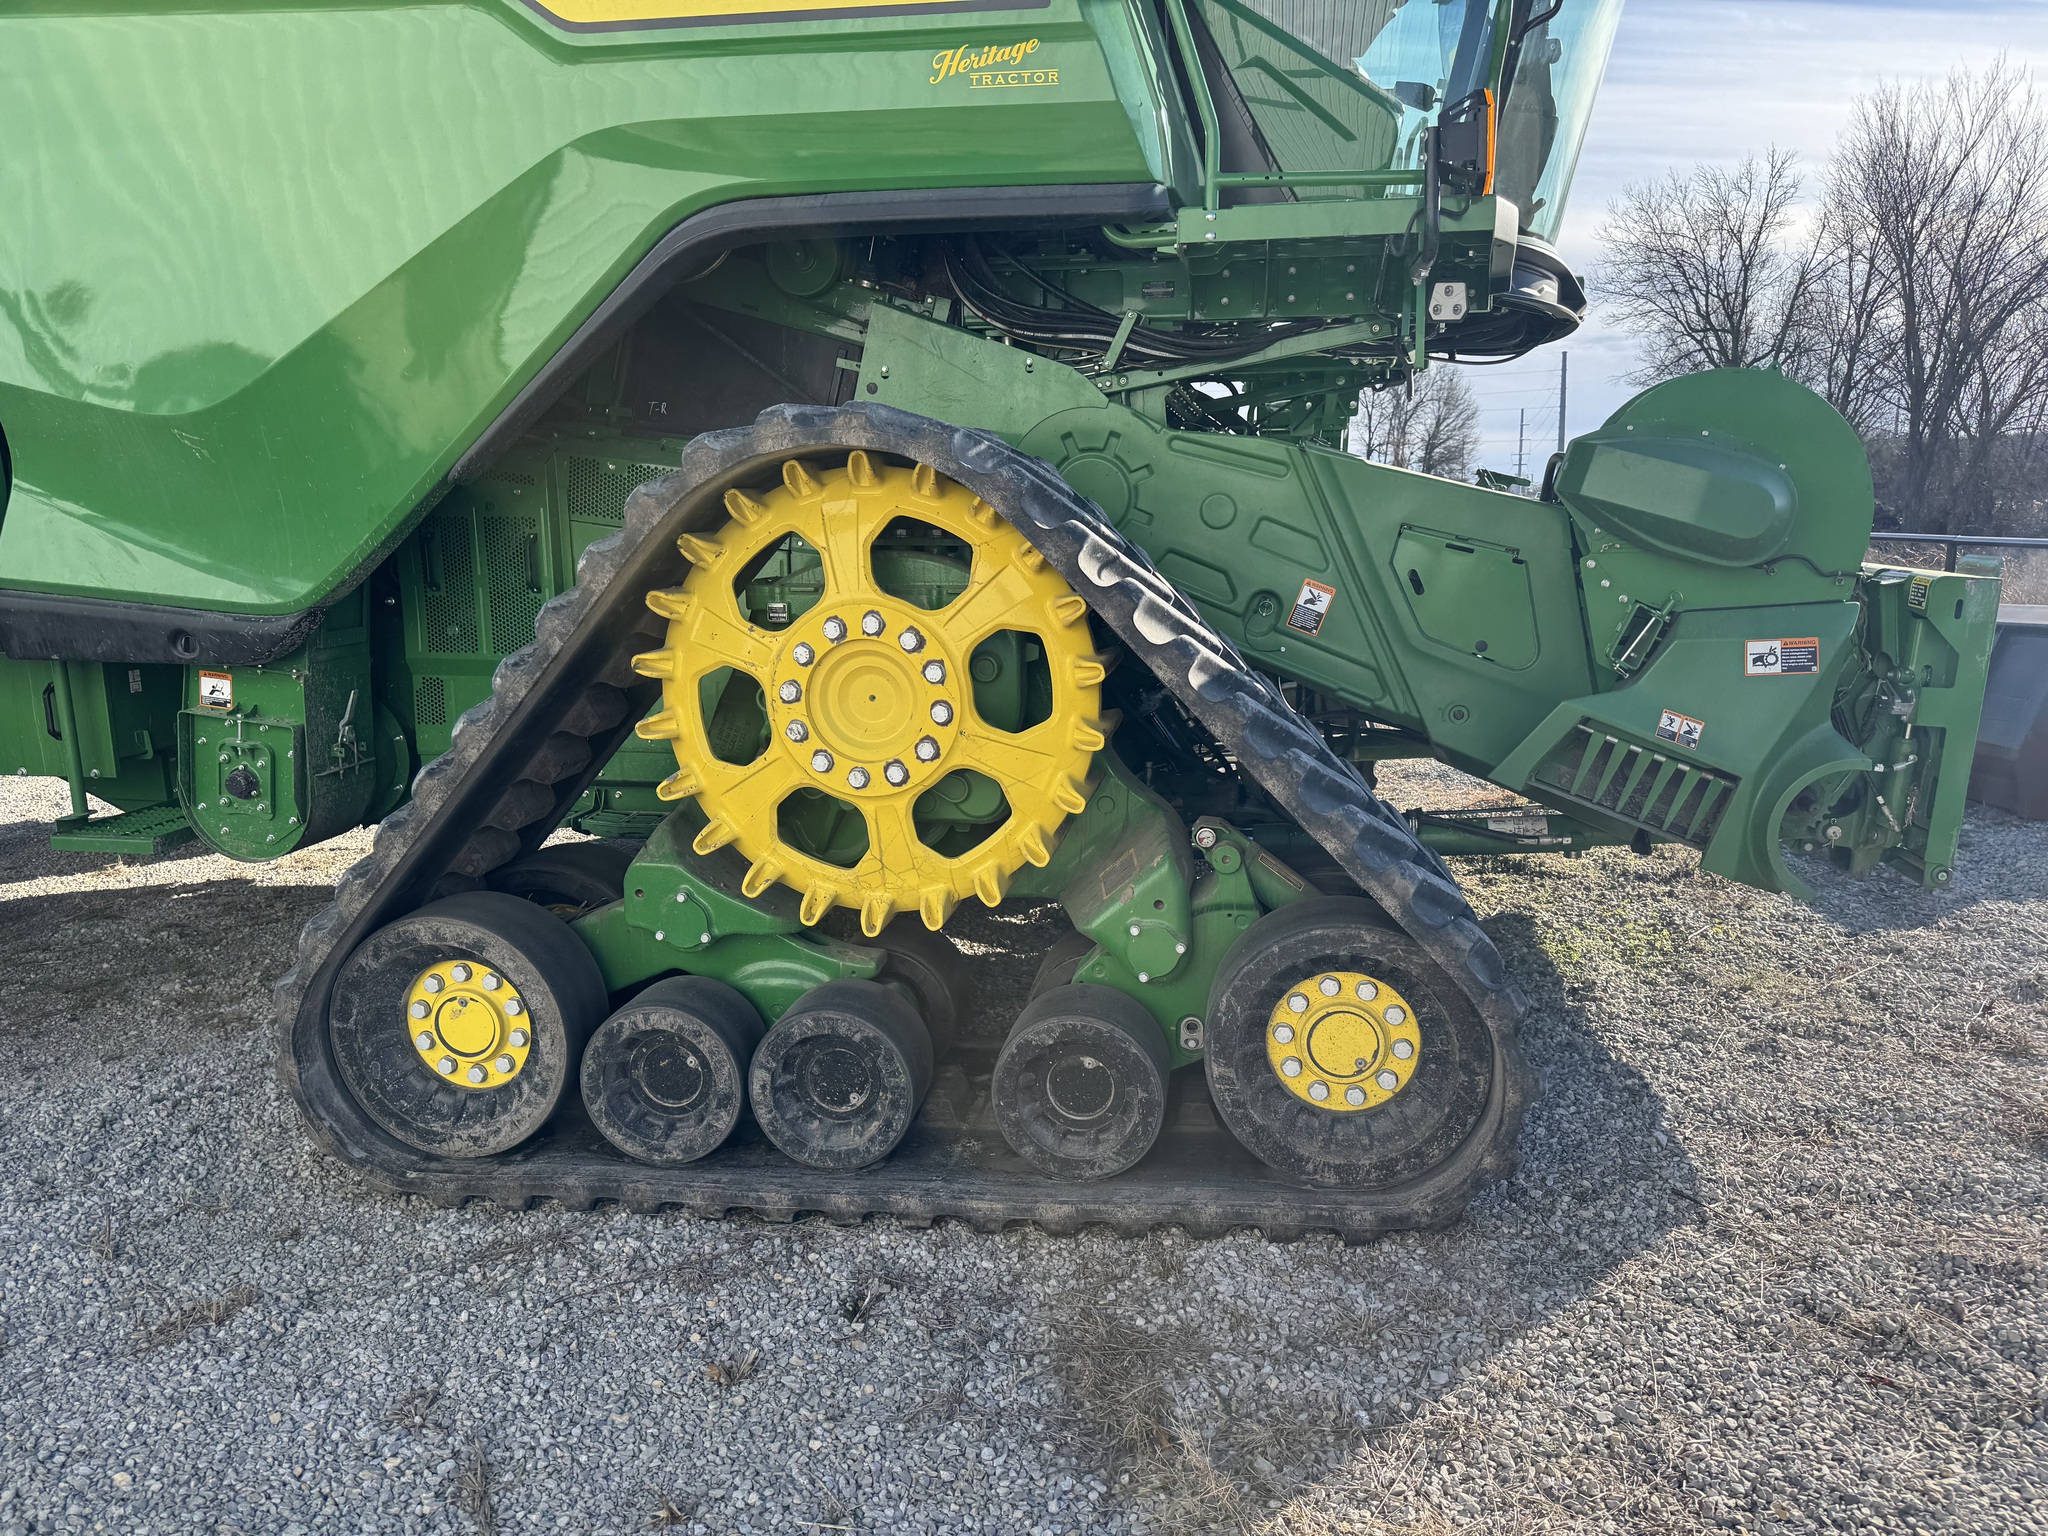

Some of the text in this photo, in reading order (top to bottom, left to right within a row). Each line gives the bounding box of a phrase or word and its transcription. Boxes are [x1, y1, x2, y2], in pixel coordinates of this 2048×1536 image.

[929, 38, 1041, 84] Heritage
[969, 72, 1059, 86] TRACTOR
[648, 401, 667, 415] T-R
[1311, 582, 1334, 594] WARNING
